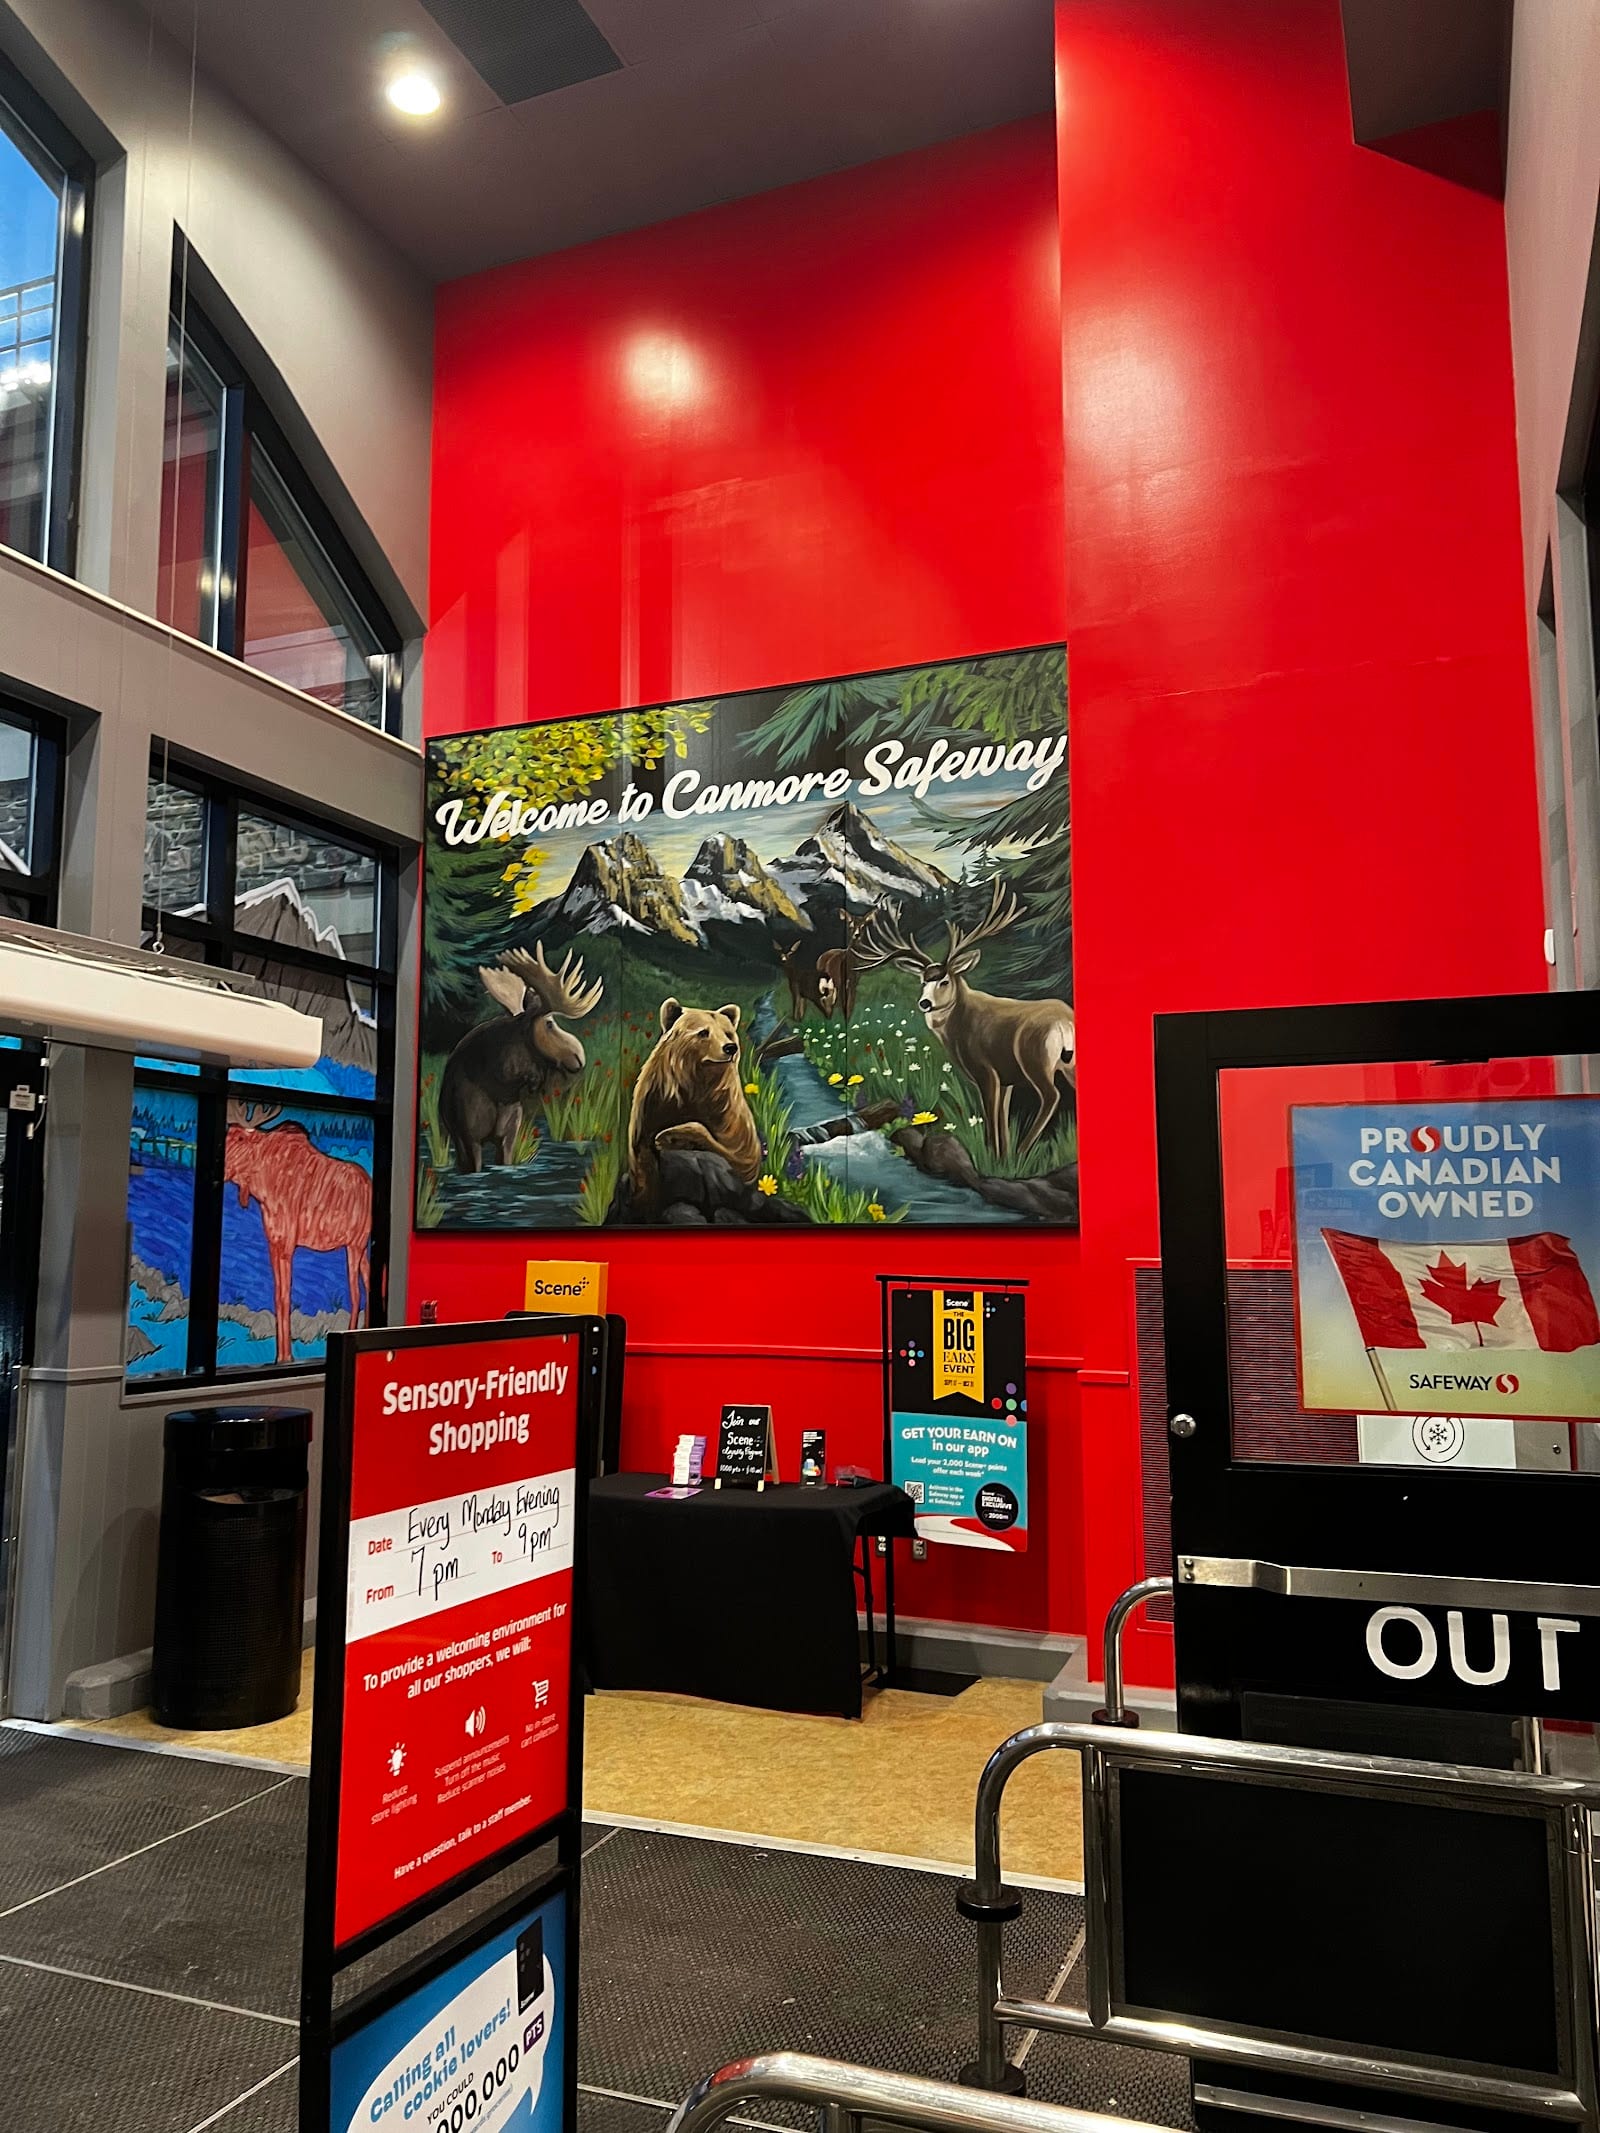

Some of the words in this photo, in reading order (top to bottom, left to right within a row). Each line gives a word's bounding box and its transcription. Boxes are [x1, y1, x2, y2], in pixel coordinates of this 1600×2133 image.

[435, 791, 611, 846] Welcome
[618, 783, 653, 824] to
[662, 768, 852, 819] Canmore
[857, 735, 1068, 798] Safeway
[1349, 1157, 1561, 1187] CANADIAN
[1378, 1190, 1534, 1218] OWNED
[944, 1318, 975, 1351] BIG
[943, 1352, 976, 1363] EARN
[943, 1365, 975, 1374] EVENT
[382, 1362, 568, 1415] Sensory-Friendly
[1409, 1374, 1493, 1391] SAFEWAY
[429, 1411, 530, 1455] Shopping
[722, 1410, 745, 1429] Join
[902, 1427, 925, 1439] GET
[927, 1427, 961, 1439] YOUR
[963, 1428, 996, 1443] EARN
[997, 1435, 1017, 1448] ON
[932, 1439, 944, 1451] in
[945, 1442, 965, 1452] our
[967, 1444, 990, 1457] app
[408, 1508, 450, 1550] Every
[462, 1494, 512, 1536] Monday
[516, 1485, 560, 1528] Evening
[368, 1537, 393, 1556] Date
[492, 1551, 503, 1564] To
[366, 1584, 394, 1604] From
[363, 1674, 378, 1691] To
[380, 1655, 424, 1688] provide
[426, 1653, 433, 1667] a
[436, 1631, 490, 1663] welcoming
[492, 1607, 551, 1642] environment
[553, 1603, 567, 1618] for
[1366, 1605, 1580, 1691] OUT
[407, 1679, 421, 1699] all
[423, 1673, 443, 1692] our
[444, 1653, 494, 1683] shoppers,
[495, 1646, 511, 1662] we
[434, 1757, 462, 1778] Suspend
[463, 1735, 510, 1764] announcements
[445, 1773, 460, 1786] Turn
[460, 1765, 470, 1779] off
[471, 1762, 481, 1773] the
[482, 1752, 500, 1767] music
[382, 1785, 408, 1804] Reduce
[437, 1786, 461, 1804] Reduce
[462, 1773, 487, 1792] scanner
[486, 1762, 506, 1779] noises
[371, 1808, 390, 1824] store
[393, 1861, 415, 1879] Have
[416, 1856, 421, 1867] a
[422, 1838, 457, 1863] question,
[458, 1827, 472, 1842] talk
[473, 1823, 481, 1834] to
[482, 1820, 487, 1829] a
[488, 1808, 504, 1826] staff
[526, 2018, 543, 2047] PTS
[370, 2052, 432, 2123] Calling
[435, 2025, 455, 2061] all
[403, 2056, 457, 2121] cookie
[460, 1997, 511, 2064] lovers!
[426, 2101, 445, 2125] YOU
[446, 2072, 474, 2105] COULD
